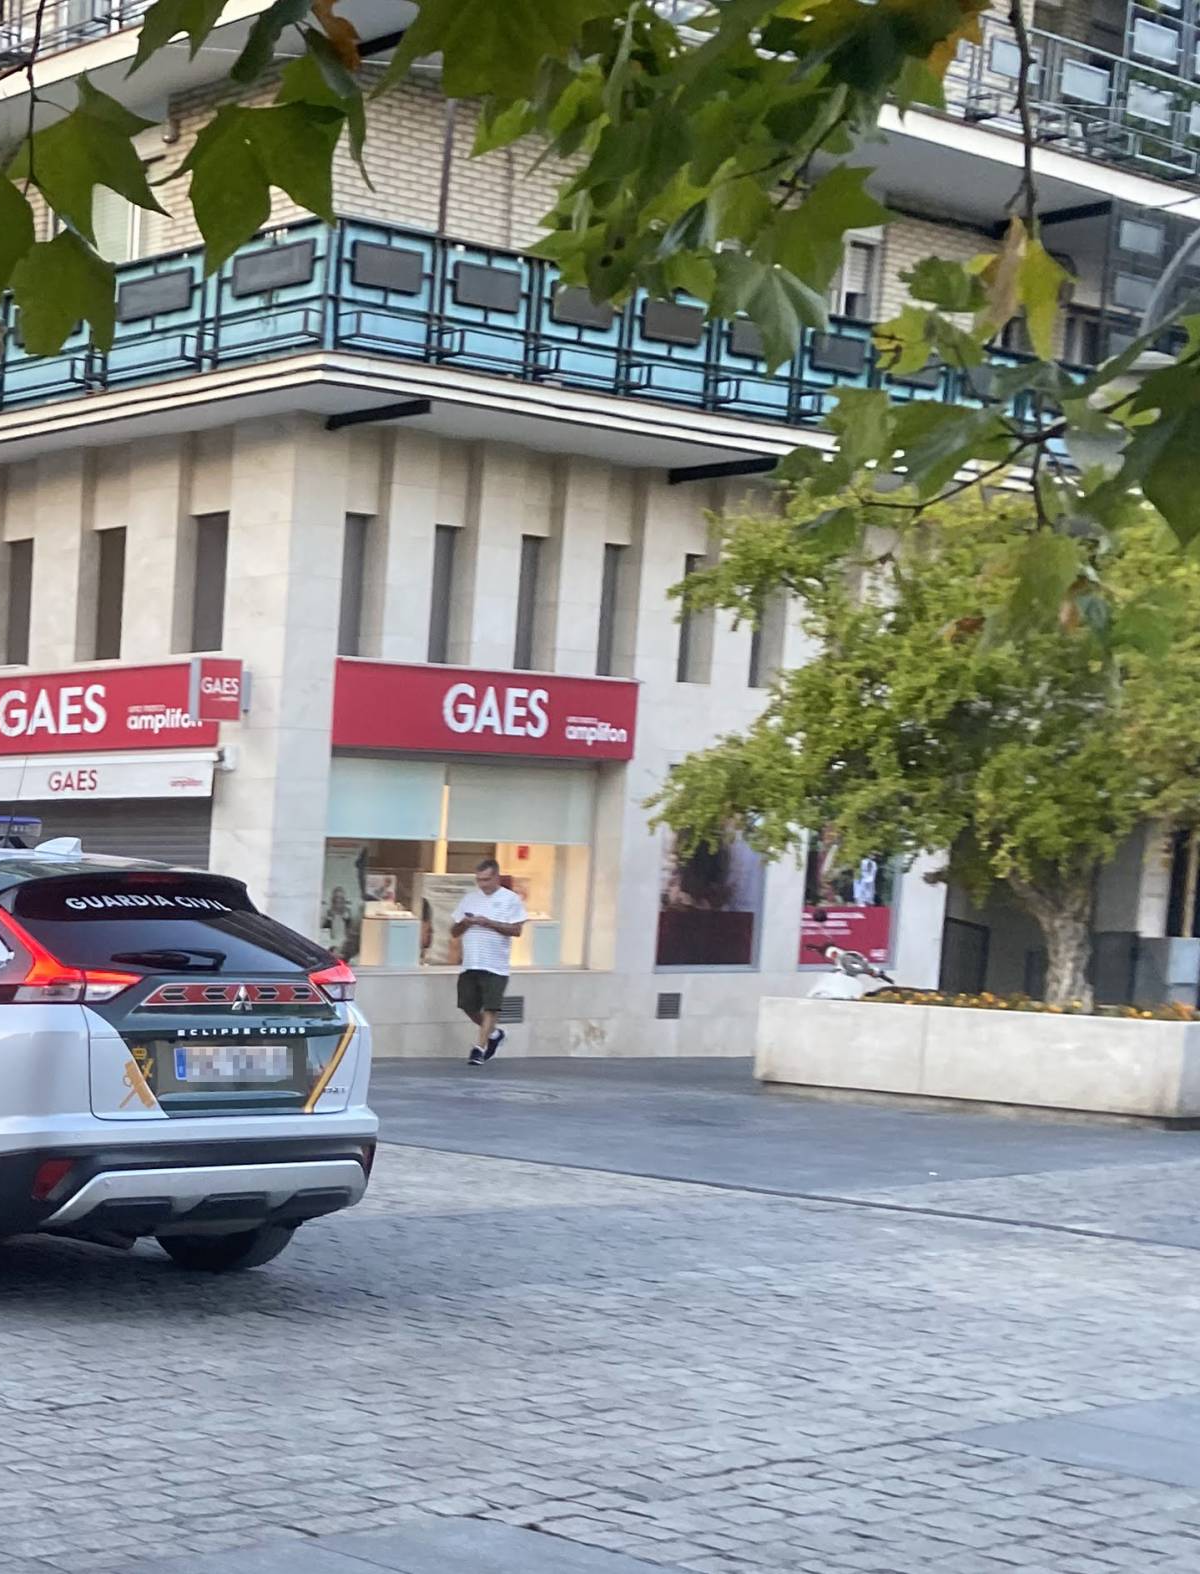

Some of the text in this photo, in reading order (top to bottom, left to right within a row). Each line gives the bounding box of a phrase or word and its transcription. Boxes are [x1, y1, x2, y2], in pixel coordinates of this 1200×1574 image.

[201, 677, 240, 695] GAES
[442, 682, 628, 747] GAES amplifon
[48, 769, 98, 792] GAES
[65, 893, 233, 913] GUARDIA CIVIL
[177, 1026, 307, 1037] ECLIPSE CROSS
